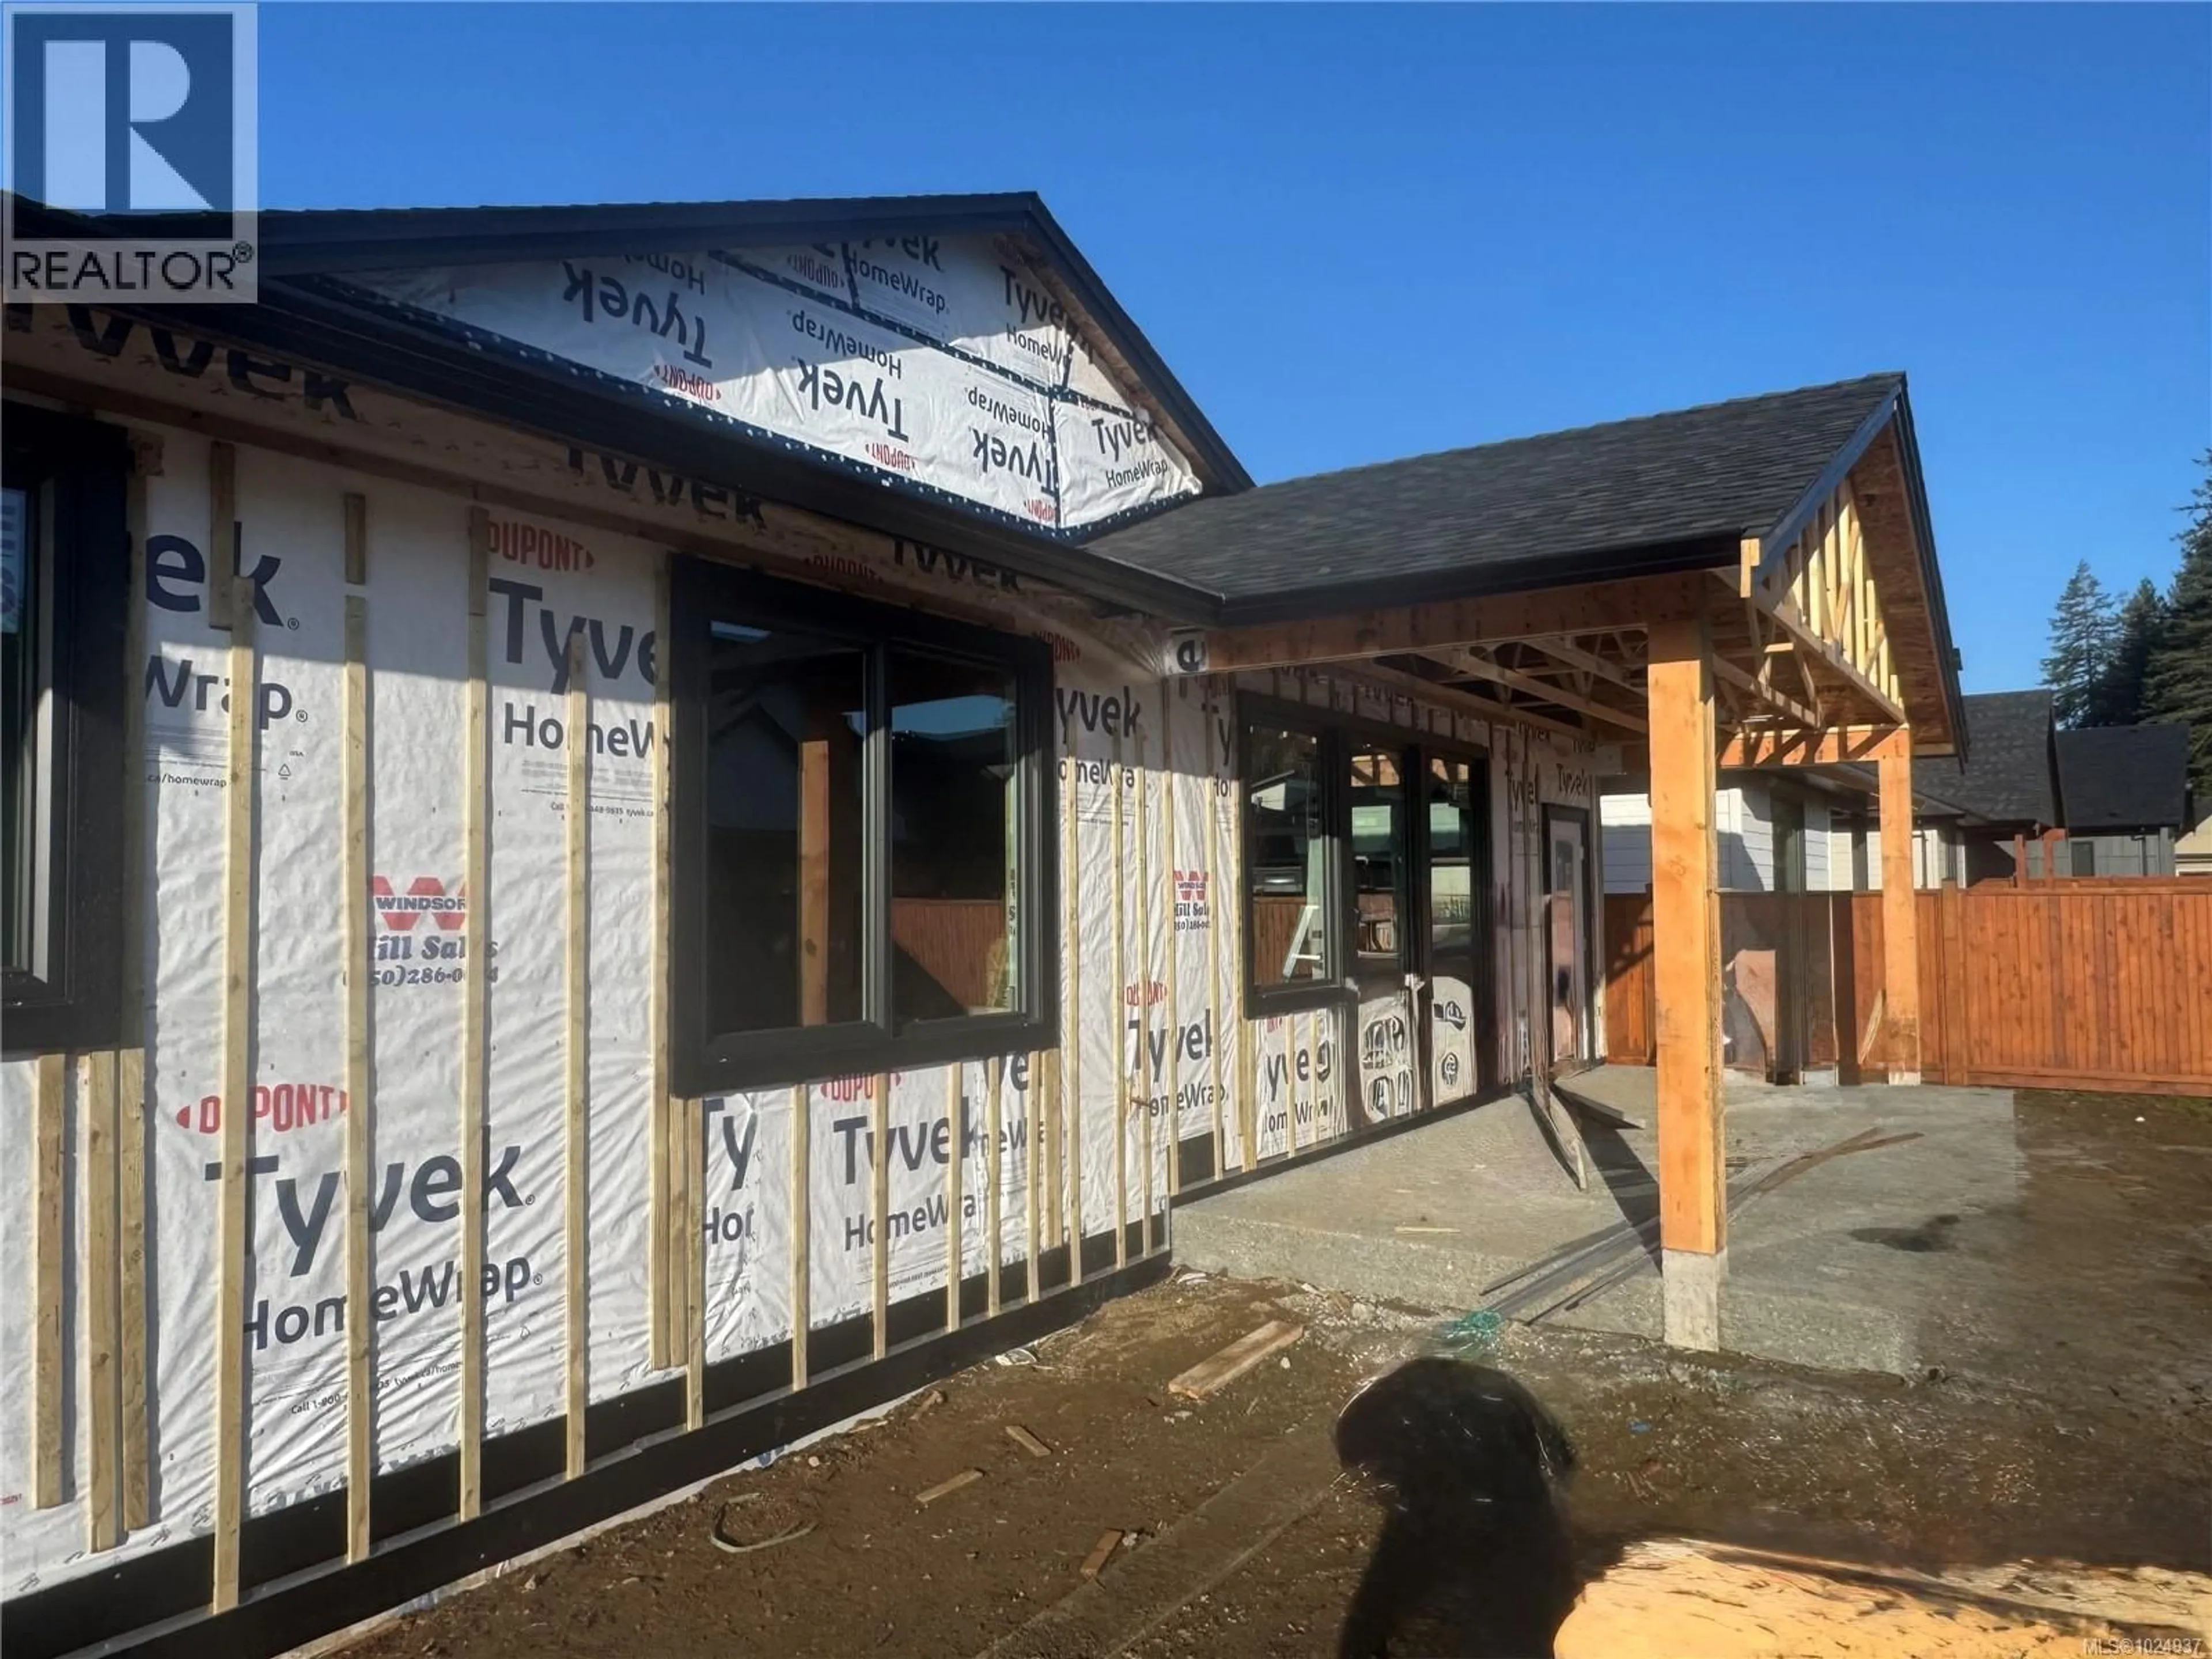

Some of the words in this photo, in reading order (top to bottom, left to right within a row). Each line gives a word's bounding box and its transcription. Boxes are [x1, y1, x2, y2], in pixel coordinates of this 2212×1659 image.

[562, 261, 713, 369] Tyvek
[793, 310, 902, 379] HomeWrap
[798, 358, 909, 442] Tyvek
[972, 427, 1055, 496] Tyvek
[1105, 459, 1168, 488] HomeWrap
